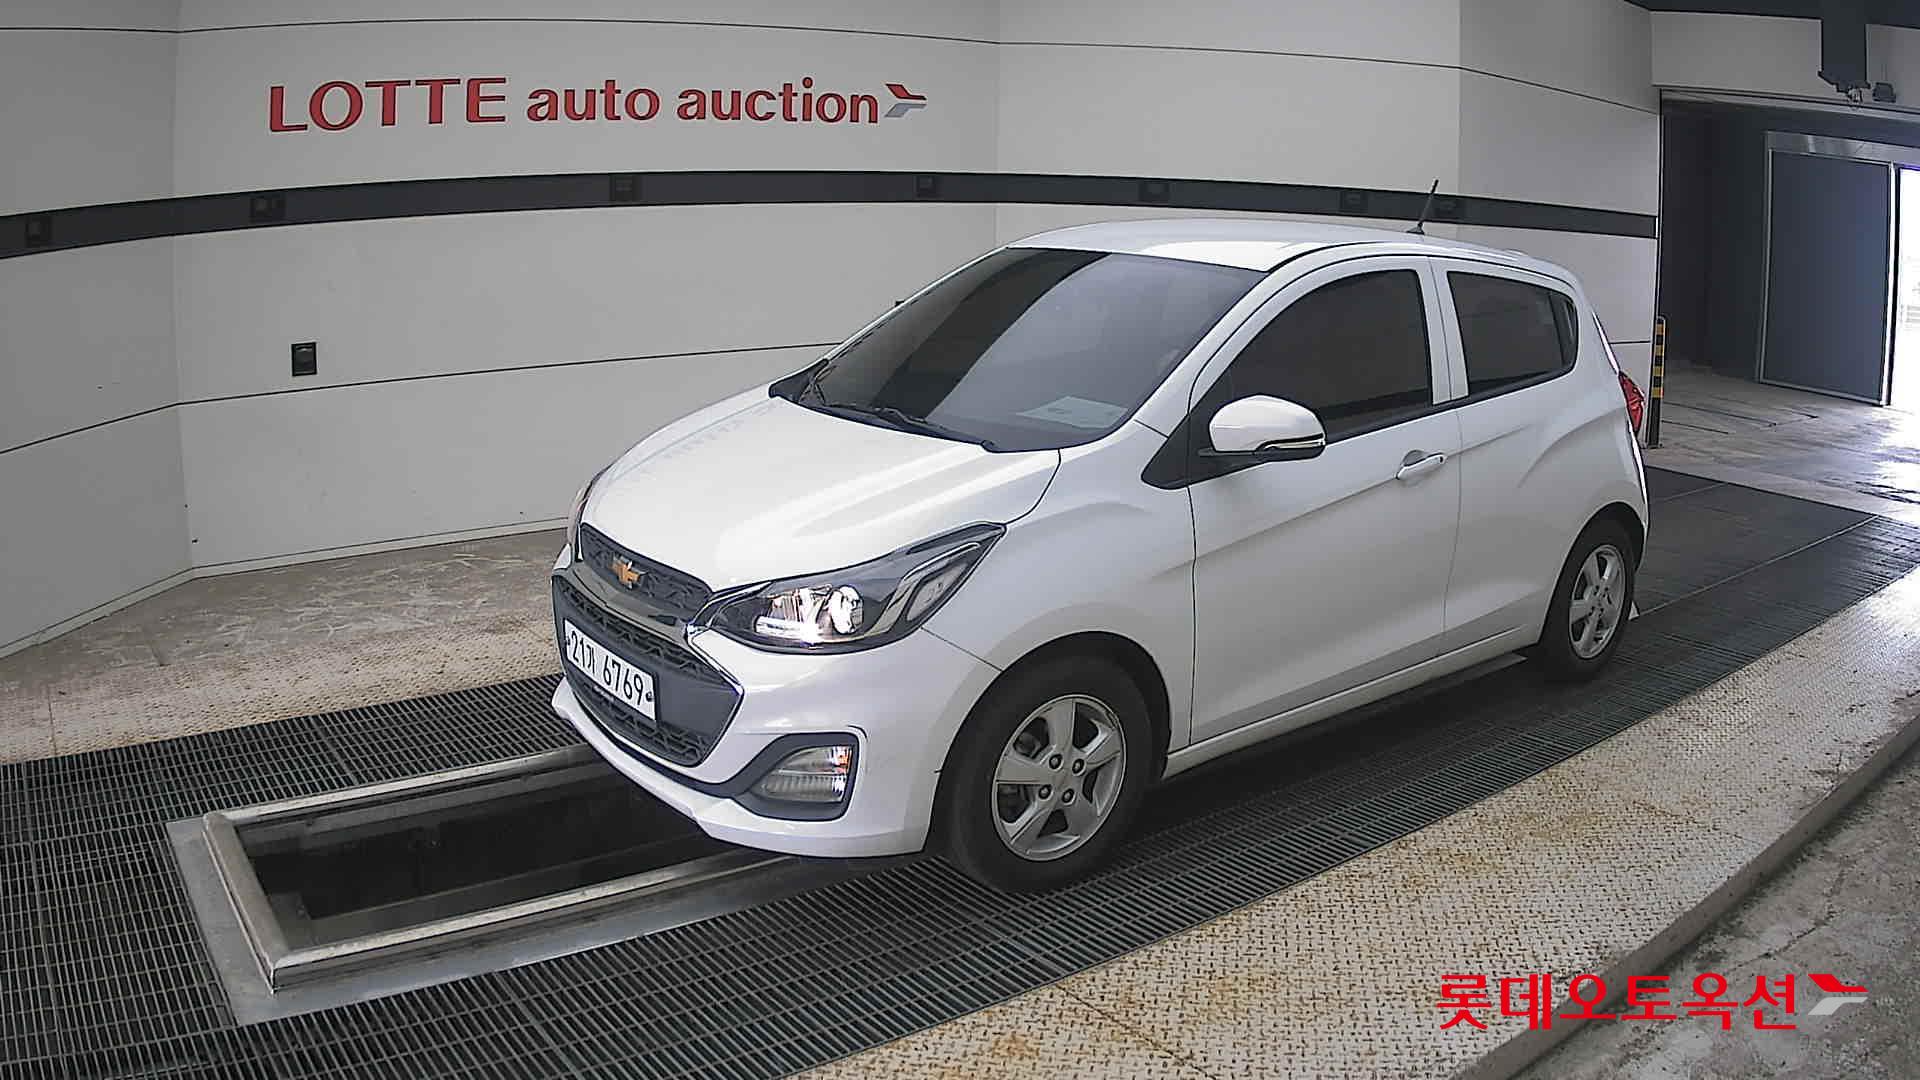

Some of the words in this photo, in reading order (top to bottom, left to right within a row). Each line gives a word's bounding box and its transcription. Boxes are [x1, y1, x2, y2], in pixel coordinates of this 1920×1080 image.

[269, 77, 506, 133] LOTTE
[526, 79, 660, 122] auto
[675, 77, 879, 124] auction
[603, 655, 644, 706] 6769
